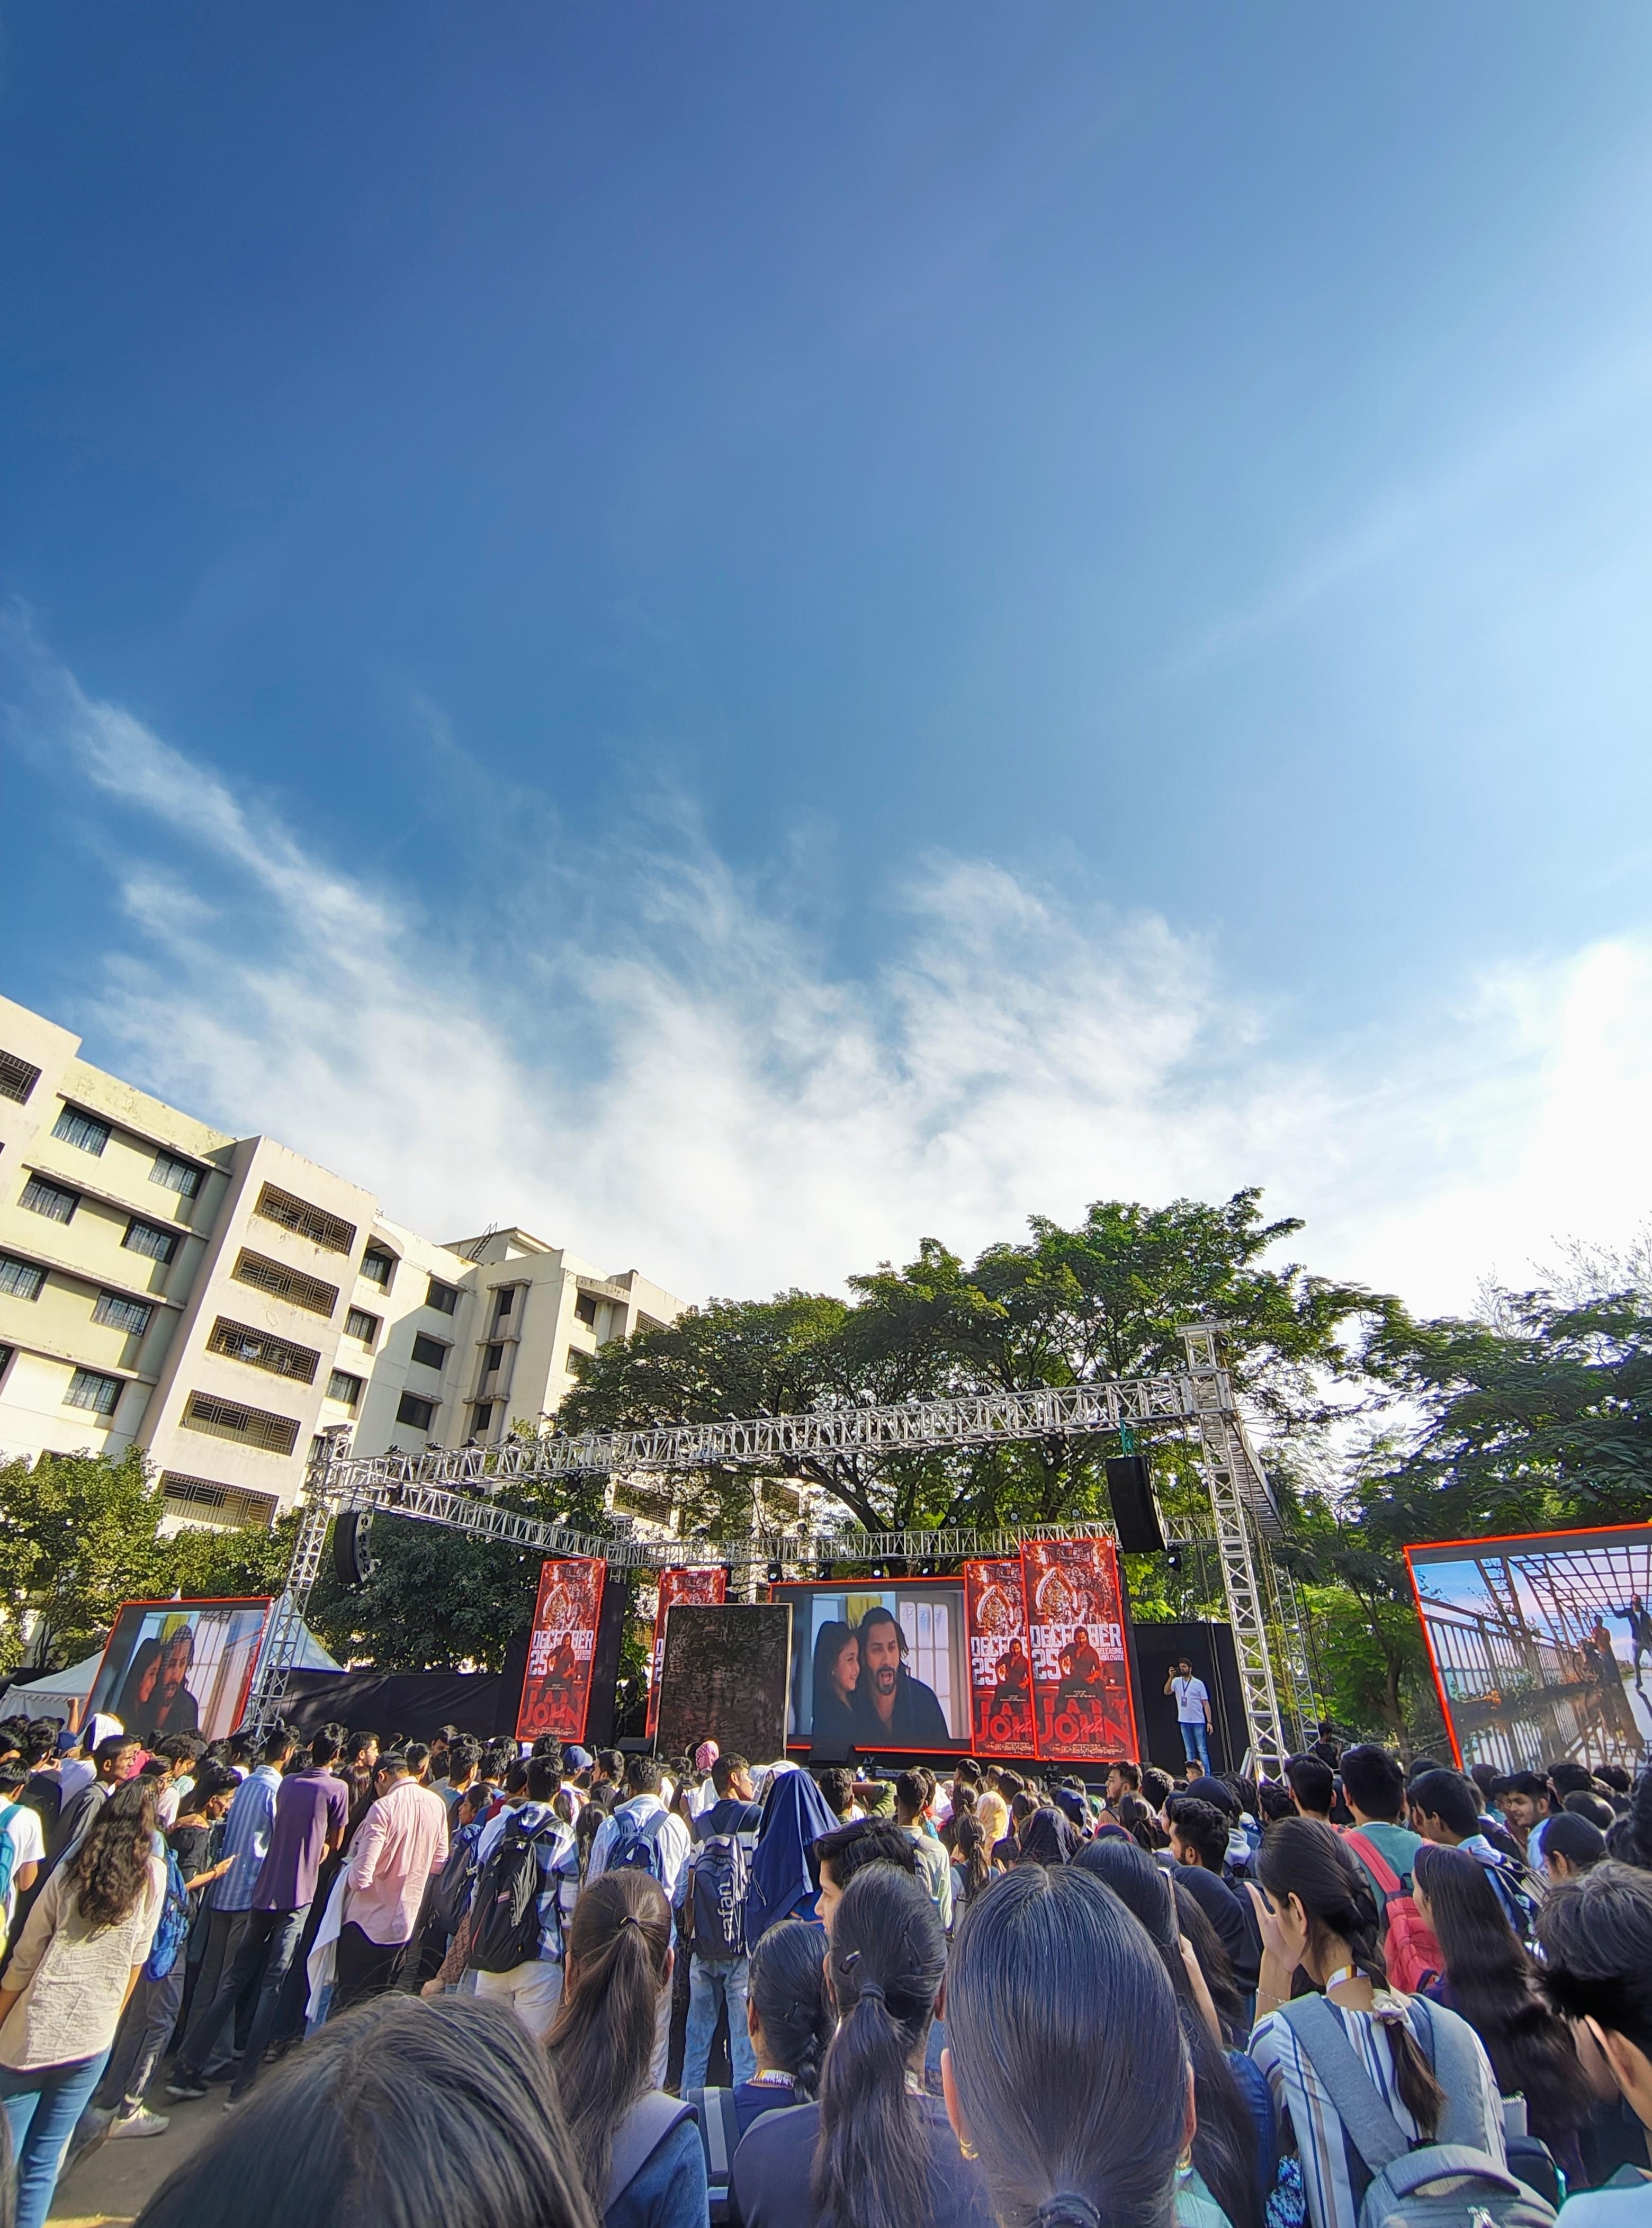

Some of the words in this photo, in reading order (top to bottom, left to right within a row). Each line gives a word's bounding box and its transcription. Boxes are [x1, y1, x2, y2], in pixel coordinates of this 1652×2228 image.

[532, 1630, 594, 1650] DECEBER
[1029, 1623, 1122, 1648] DECEBER
[528, 1650, 549, 1676] 25
[972, 1657, 998, 1685] 25
[1031, 1648, 1062, 1680] 25
[1038, 1713, 1132, 1746] JOHN
